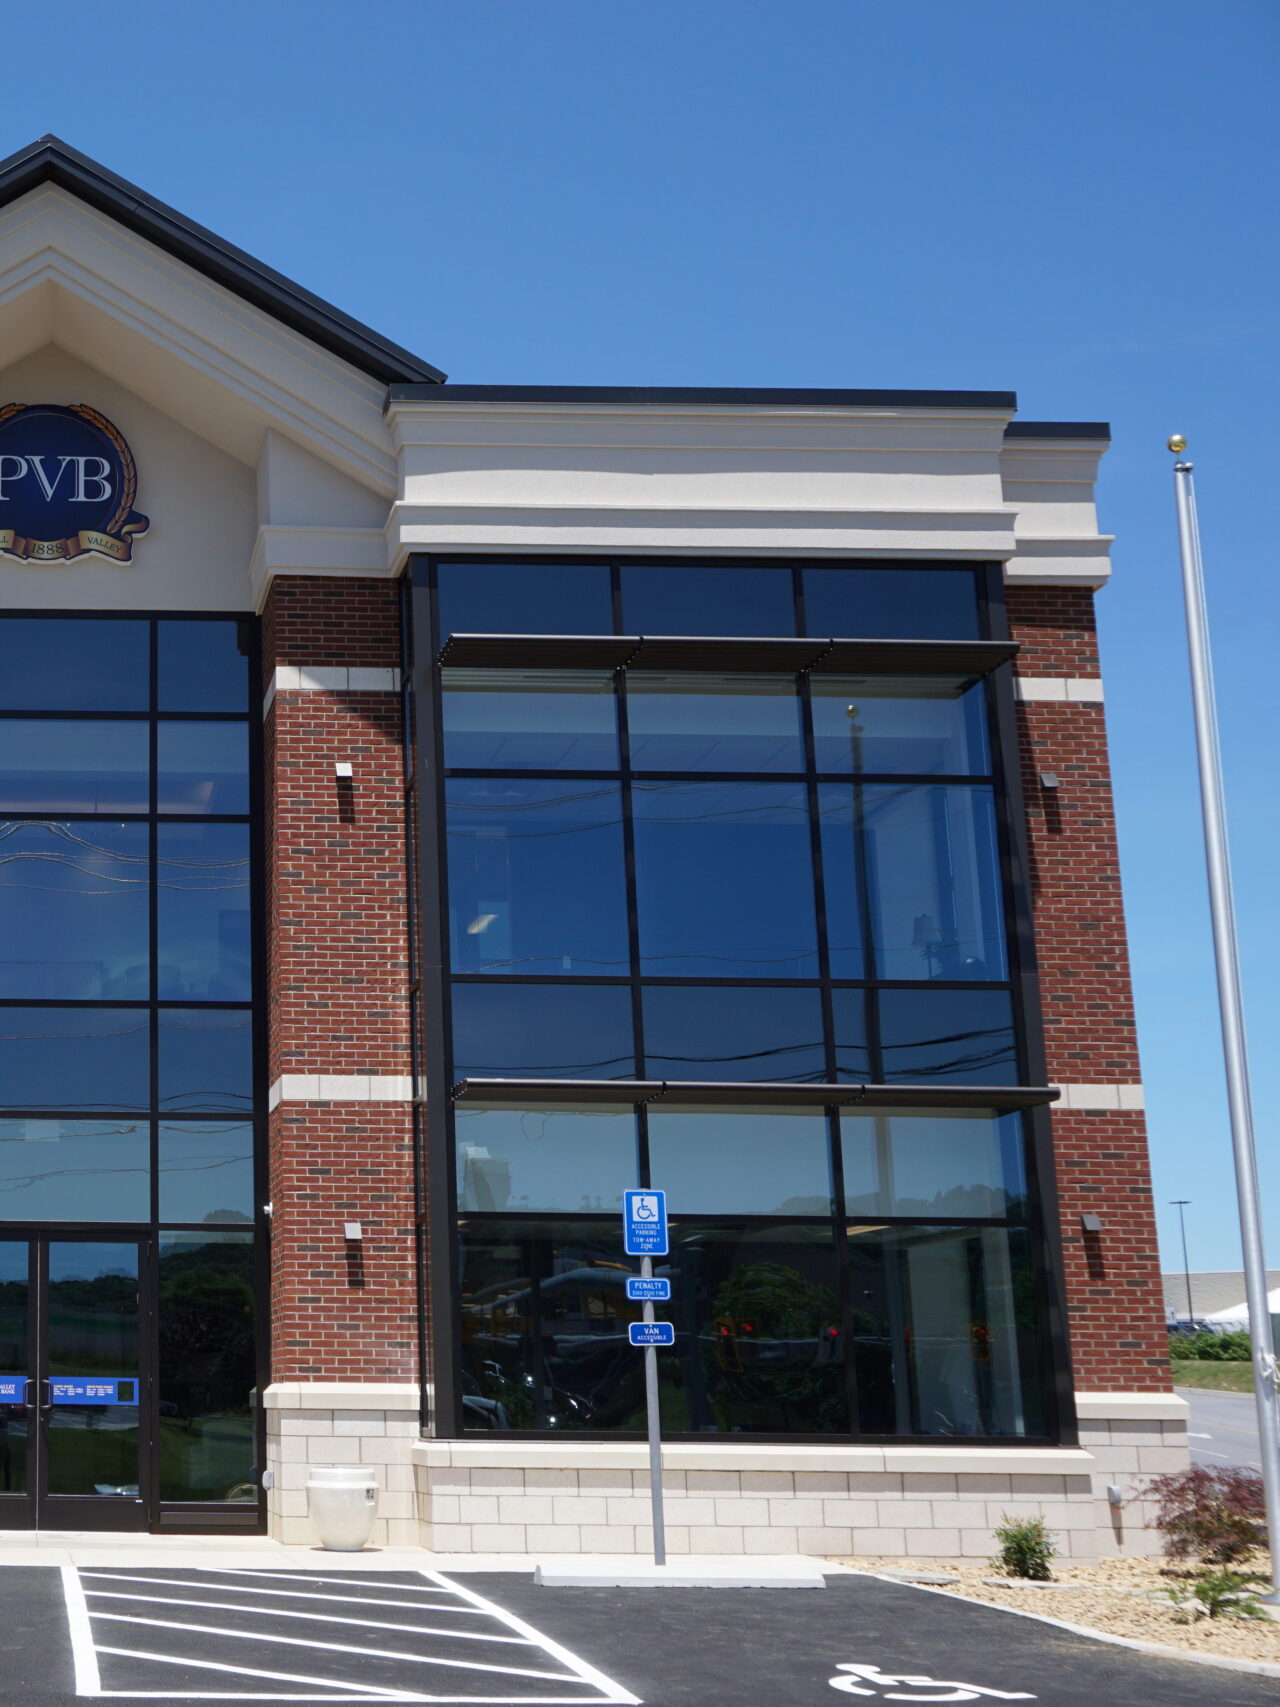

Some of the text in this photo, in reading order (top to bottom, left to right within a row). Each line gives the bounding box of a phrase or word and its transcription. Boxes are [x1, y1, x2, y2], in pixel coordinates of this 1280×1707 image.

[31, 543, 65, 555] 1888
[87, 536, 122, 553] VALLEY
[644, 1327, 659, 1335] VAN
